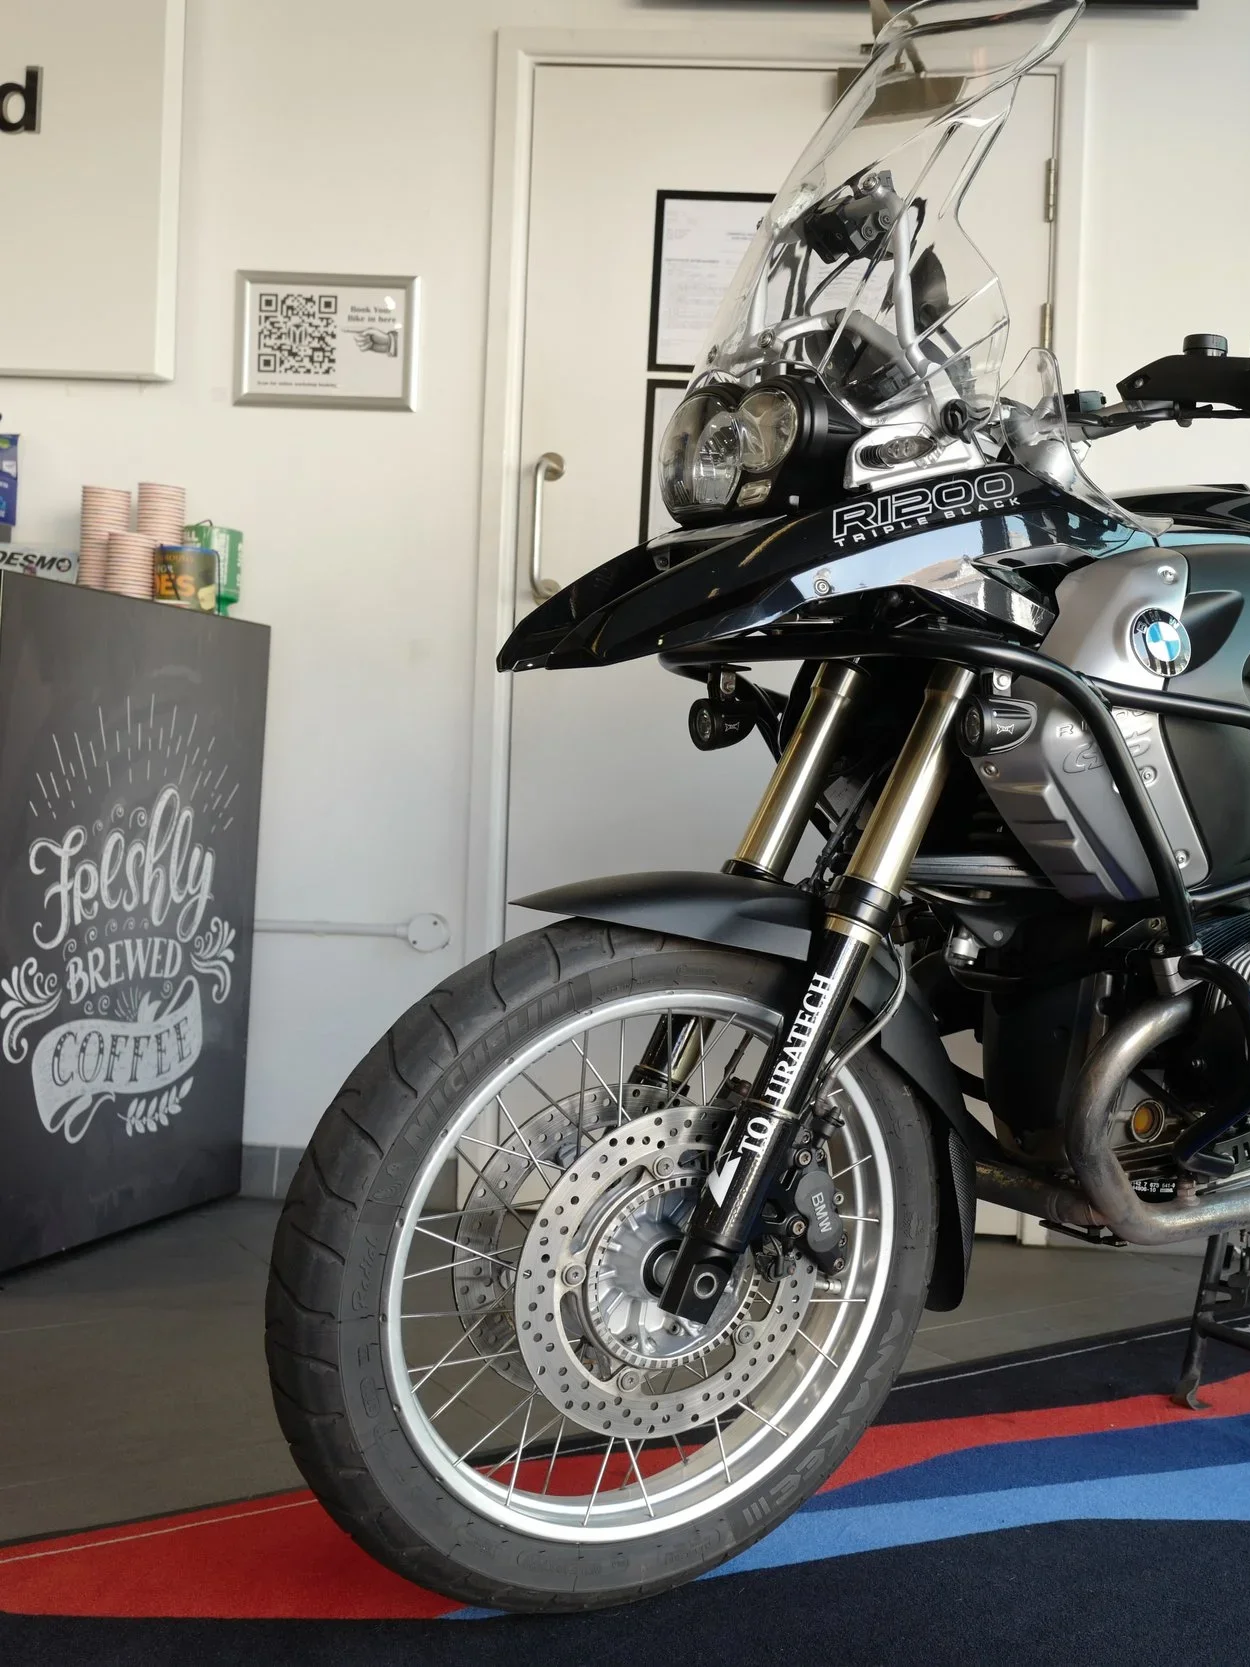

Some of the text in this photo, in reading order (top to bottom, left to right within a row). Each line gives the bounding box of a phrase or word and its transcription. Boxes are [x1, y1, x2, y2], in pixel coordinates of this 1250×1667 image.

[347, 314, 397, 324] Bike in here
[350, 305, 371, 313] Book
[834, 496, 1021, 548] TRIPLE BLACK
[28, 783, 215, 950] Freshly
[66, 936, 183, 1004] BREWED
[51, 1015, 193, 1088] COFFEE
[404, 984, 573, 1150] MICHELIN
[810, 1191, 833, 1234] BMW
[770, 1308, 905, 1507] ANAKEE
